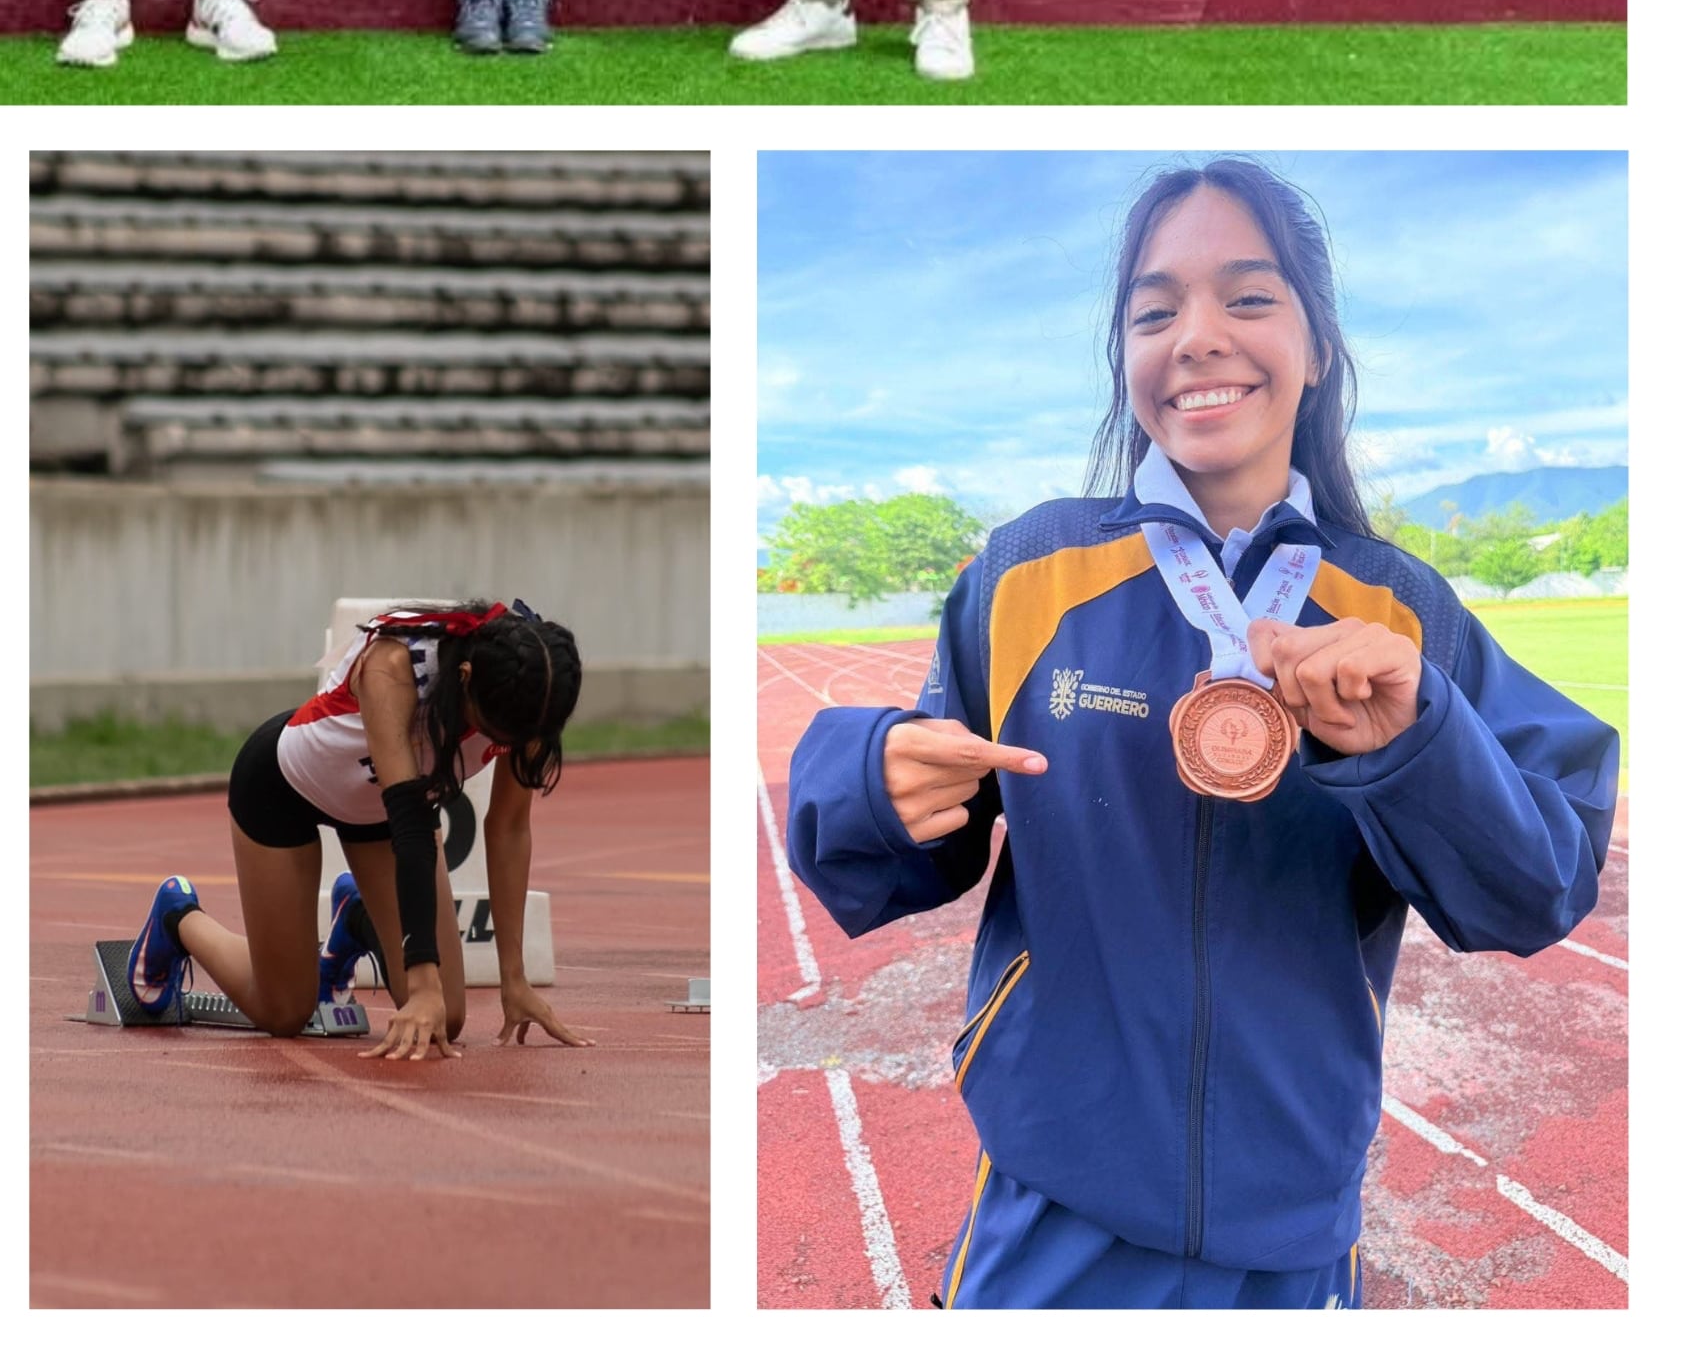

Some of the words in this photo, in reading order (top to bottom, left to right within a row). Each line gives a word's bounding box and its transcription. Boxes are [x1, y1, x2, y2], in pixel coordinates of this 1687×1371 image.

[1080, 683, 1110, 694] GOBIERNO
[1110, 687, 1122, 696] DEL
[1122, 689, 1147, 700] ESTADO
[1078, 693, 1150, 718] GUERRERO
